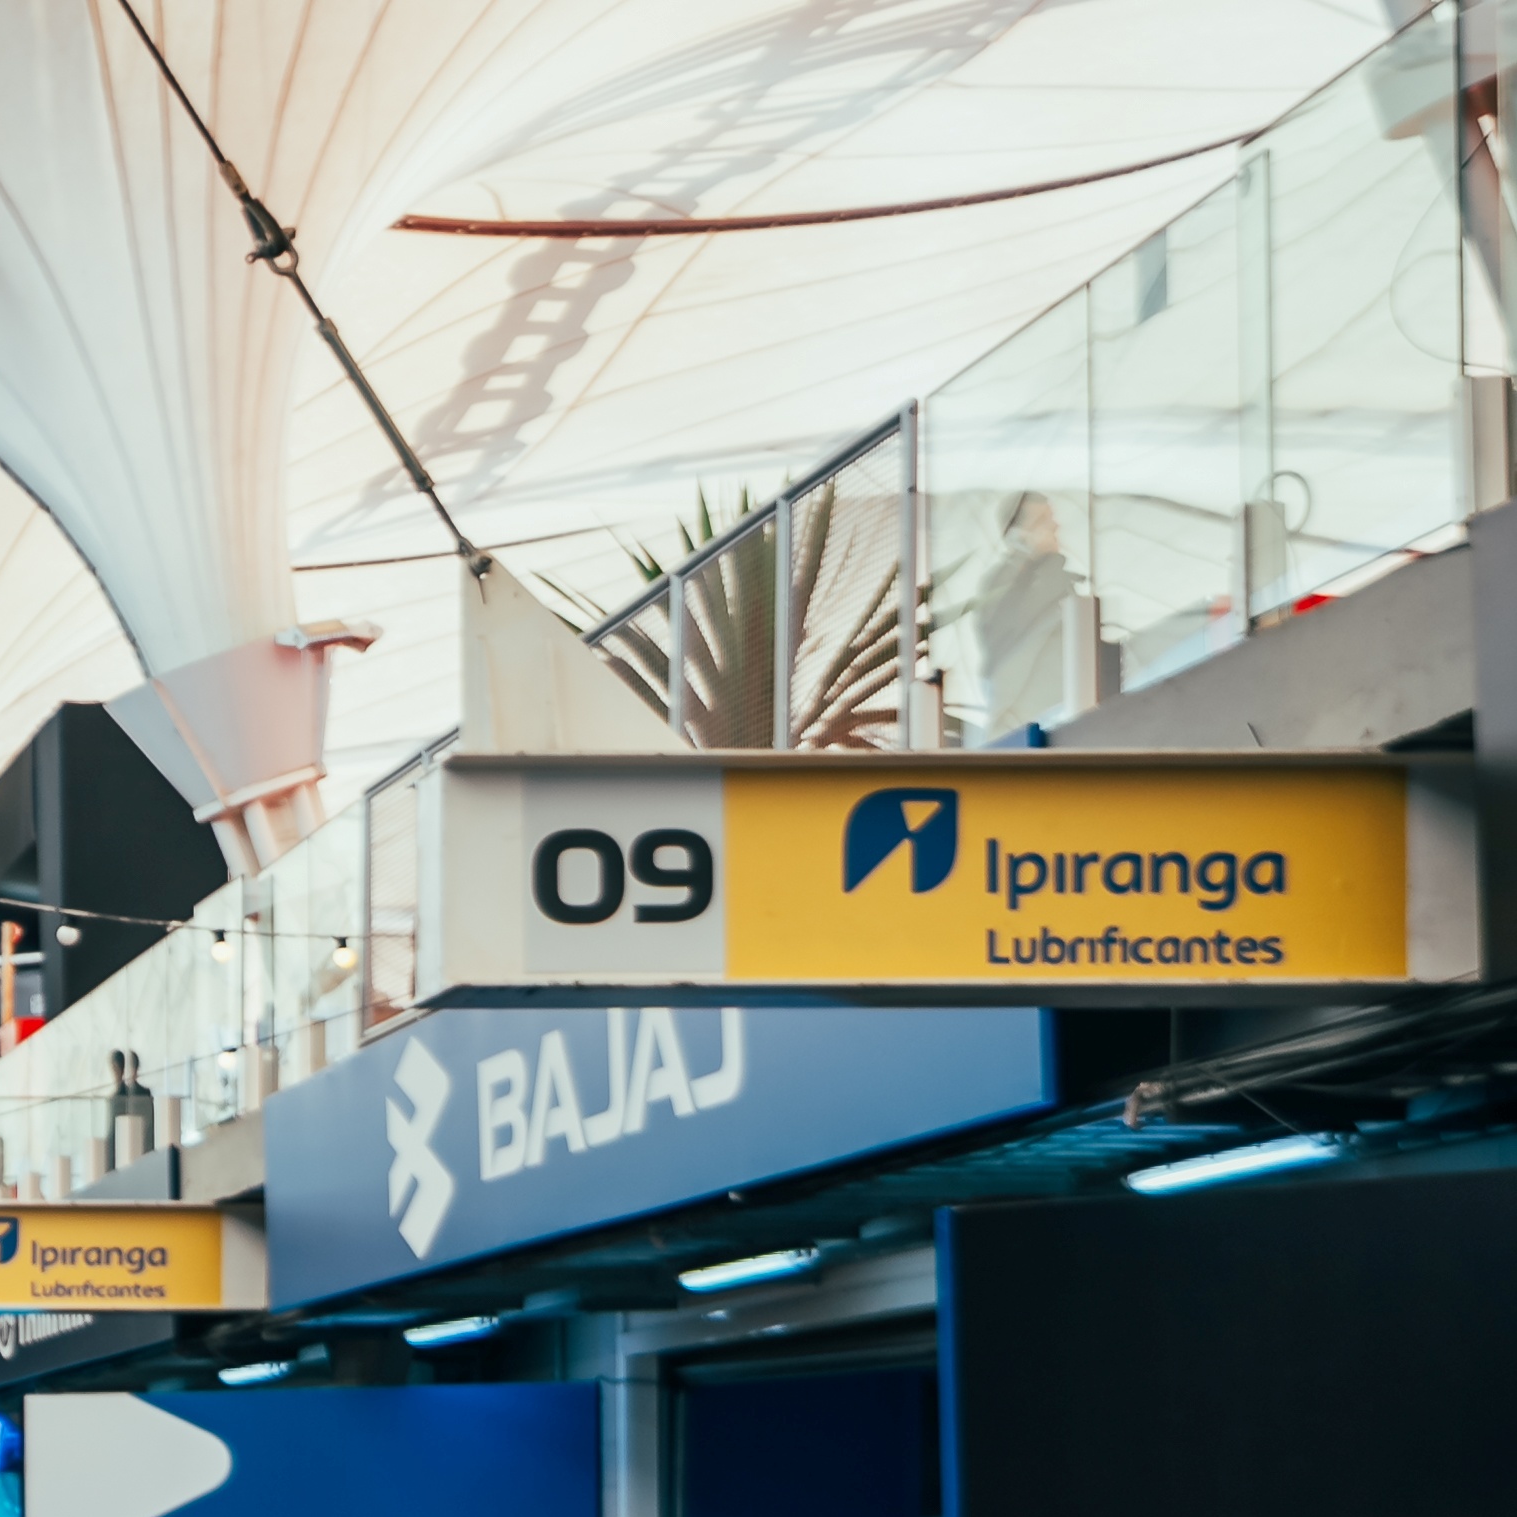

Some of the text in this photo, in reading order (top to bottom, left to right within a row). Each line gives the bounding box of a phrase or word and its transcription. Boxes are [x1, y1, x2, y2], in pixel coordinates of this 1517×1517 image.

[532, 829, 715, 925] 09
[985, 836, 1288, 911] Ipiranga
[985, 927, 1286, 966] Lubrificantes
[476, 1008, 747, 1183] BAJAJ
[30, 1240, 168, 1274] Ipiranga
[30, 1280, 167, 1299] Lubrificantes
